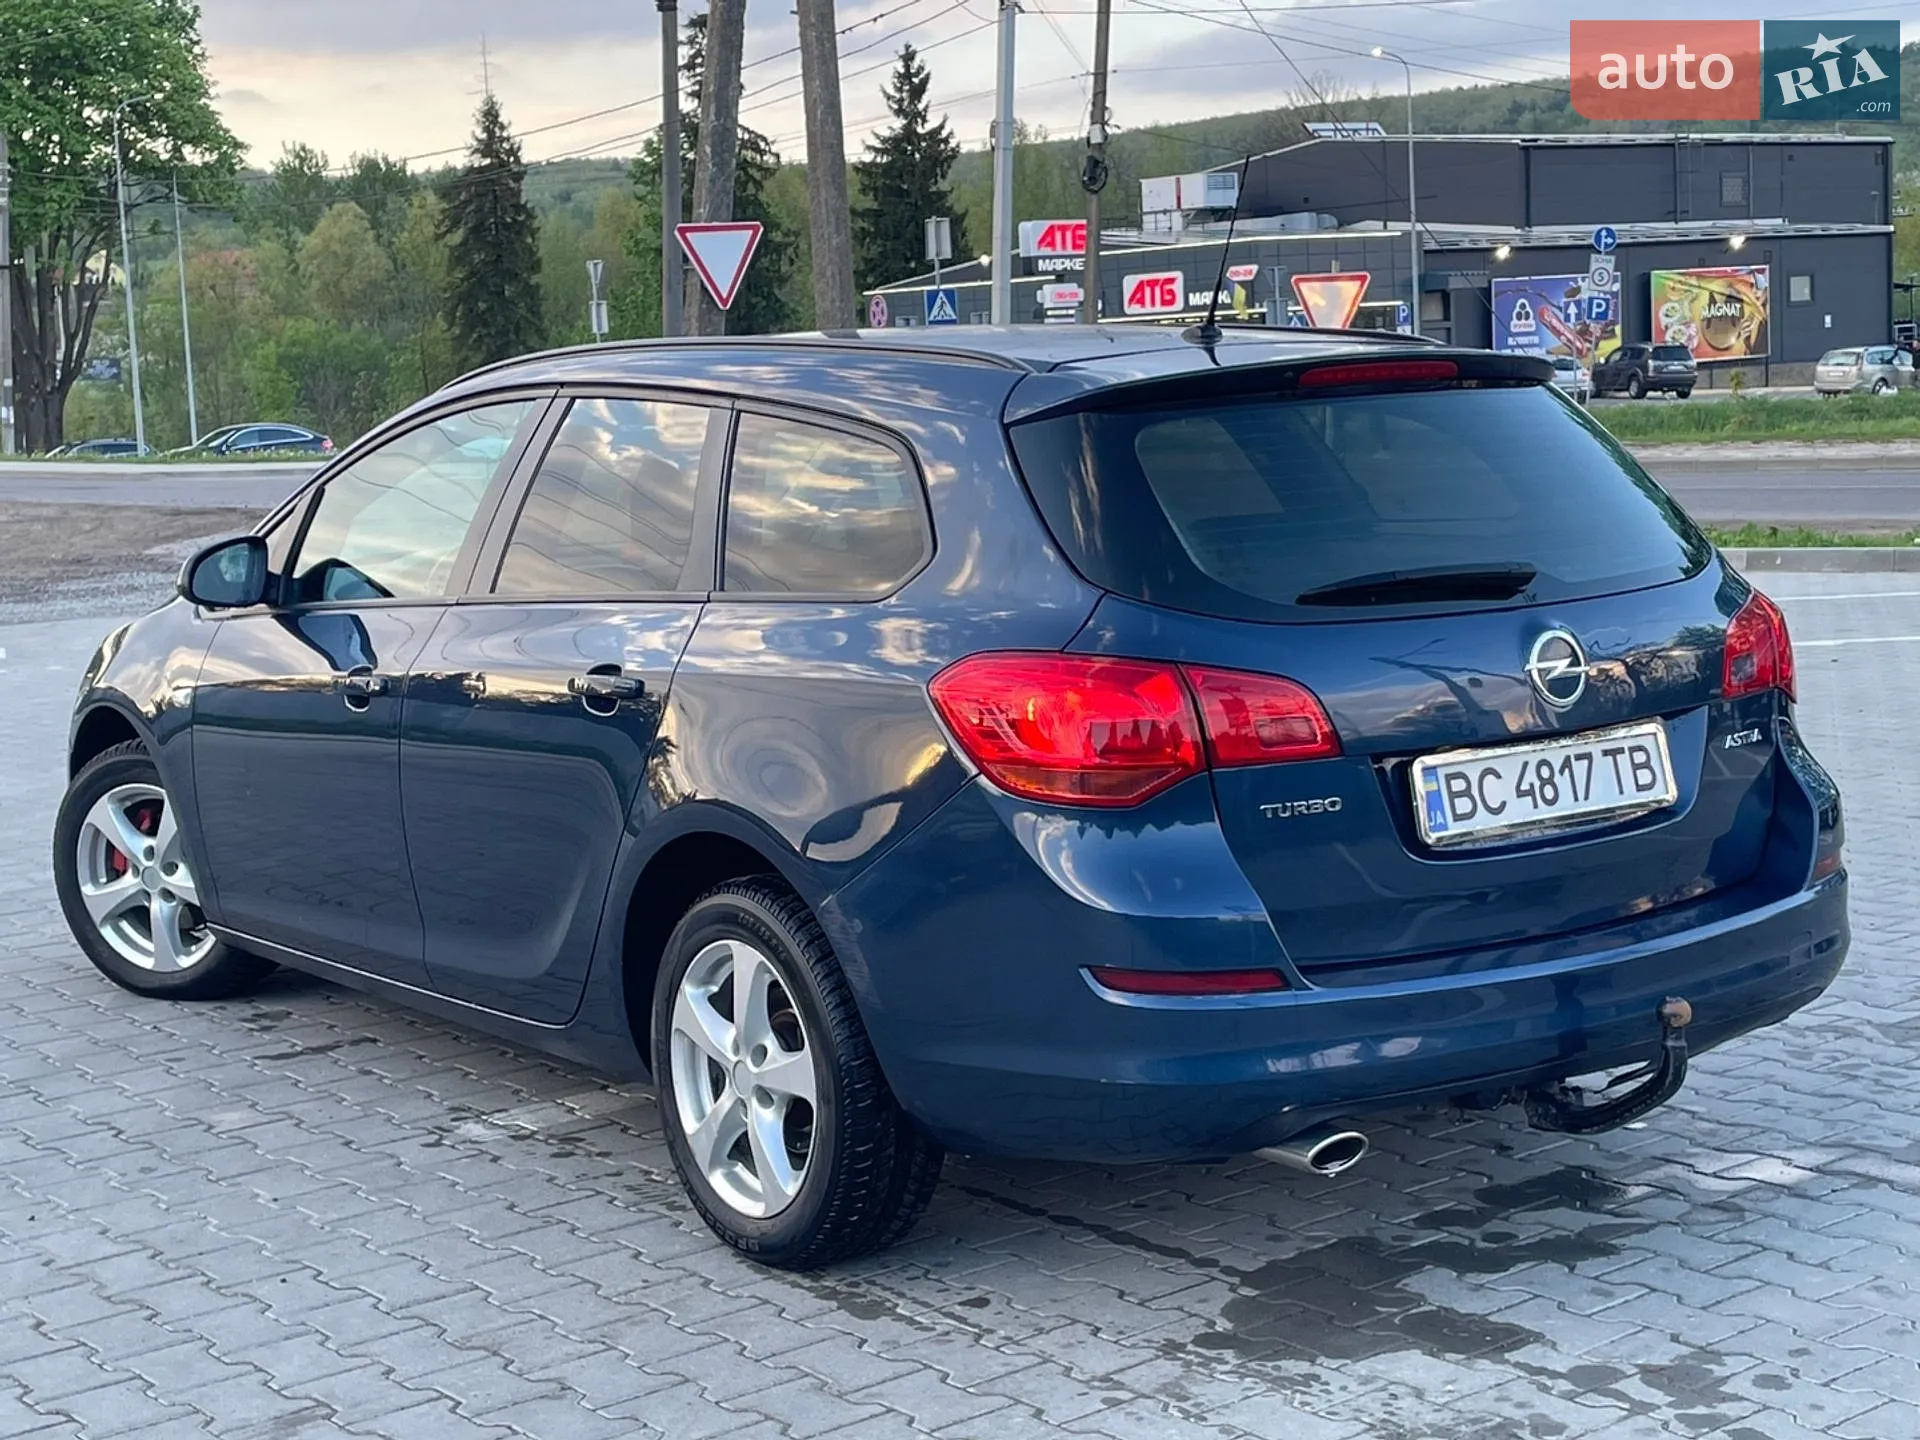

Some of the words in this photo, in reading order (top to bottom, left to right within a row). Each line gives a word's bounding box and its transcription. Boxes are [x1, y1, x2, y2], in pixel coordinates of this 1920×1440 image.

[1037, 257, 1087, 271] МАРКЕ
[1399, 305, 1409, 322] P
[1591, 298, 1606, 319] P
[1701, 303, 1741, 318] MAGNAT
[1444, 766, 1507, 823] BC
[1514, 751, 1594, 809] 4817
[1601, 744, 1657, 796] TB
[1259, 796, 1342, 819] TURBO
